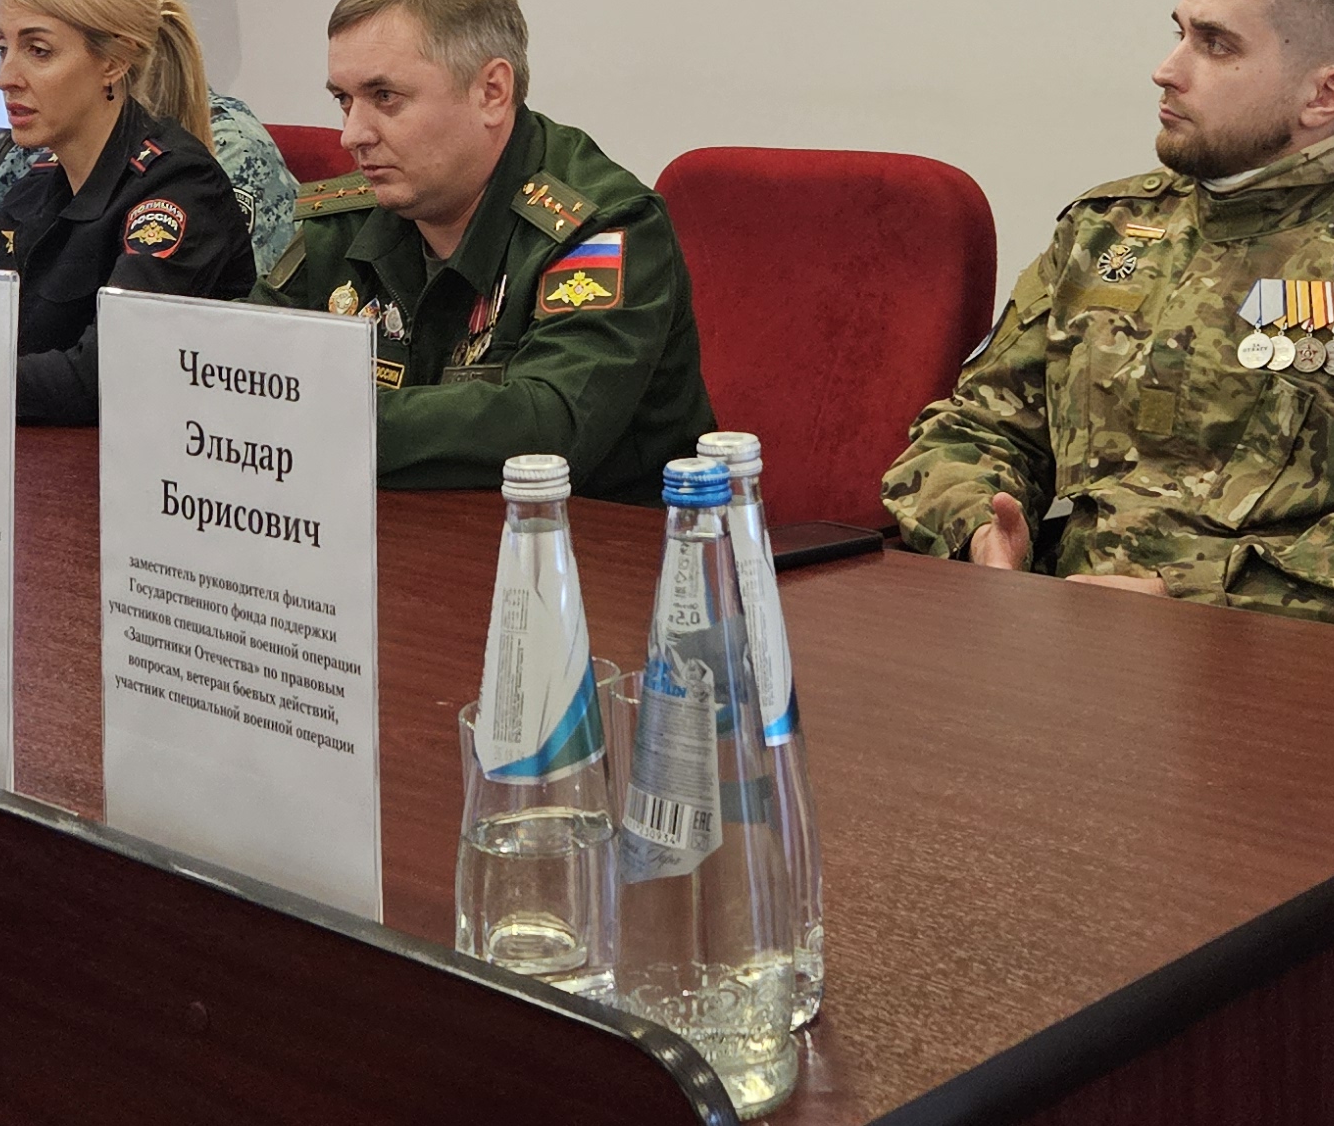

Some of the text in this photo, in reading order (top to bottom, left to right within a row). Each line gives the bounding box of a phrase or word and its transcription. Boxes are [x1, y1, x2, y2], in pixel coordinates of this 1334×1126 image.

[129, 202, 184, 222] ПОЛИЦИЯ
[130, 213, 178, 231] РОССИЯ
[179, 349, 301, 403] Чеченов
[185, 420, 294, 482] Эльдар
[161, 478, 321, 549] Борисович
[129, 556, 336, 616] заместитель руководителя филиала
[129, 577, 337, 643] Государственного фонда поддержки
[108, 600, 362, 676] участников специальной военной операции
[124, 626, 345, 698] «Защитники Отечества» по правовым
[114, 674, 355, 754] участник специальной военной операции
[128, 654, 339, 726] вопросам, ветеран боевых действий,
